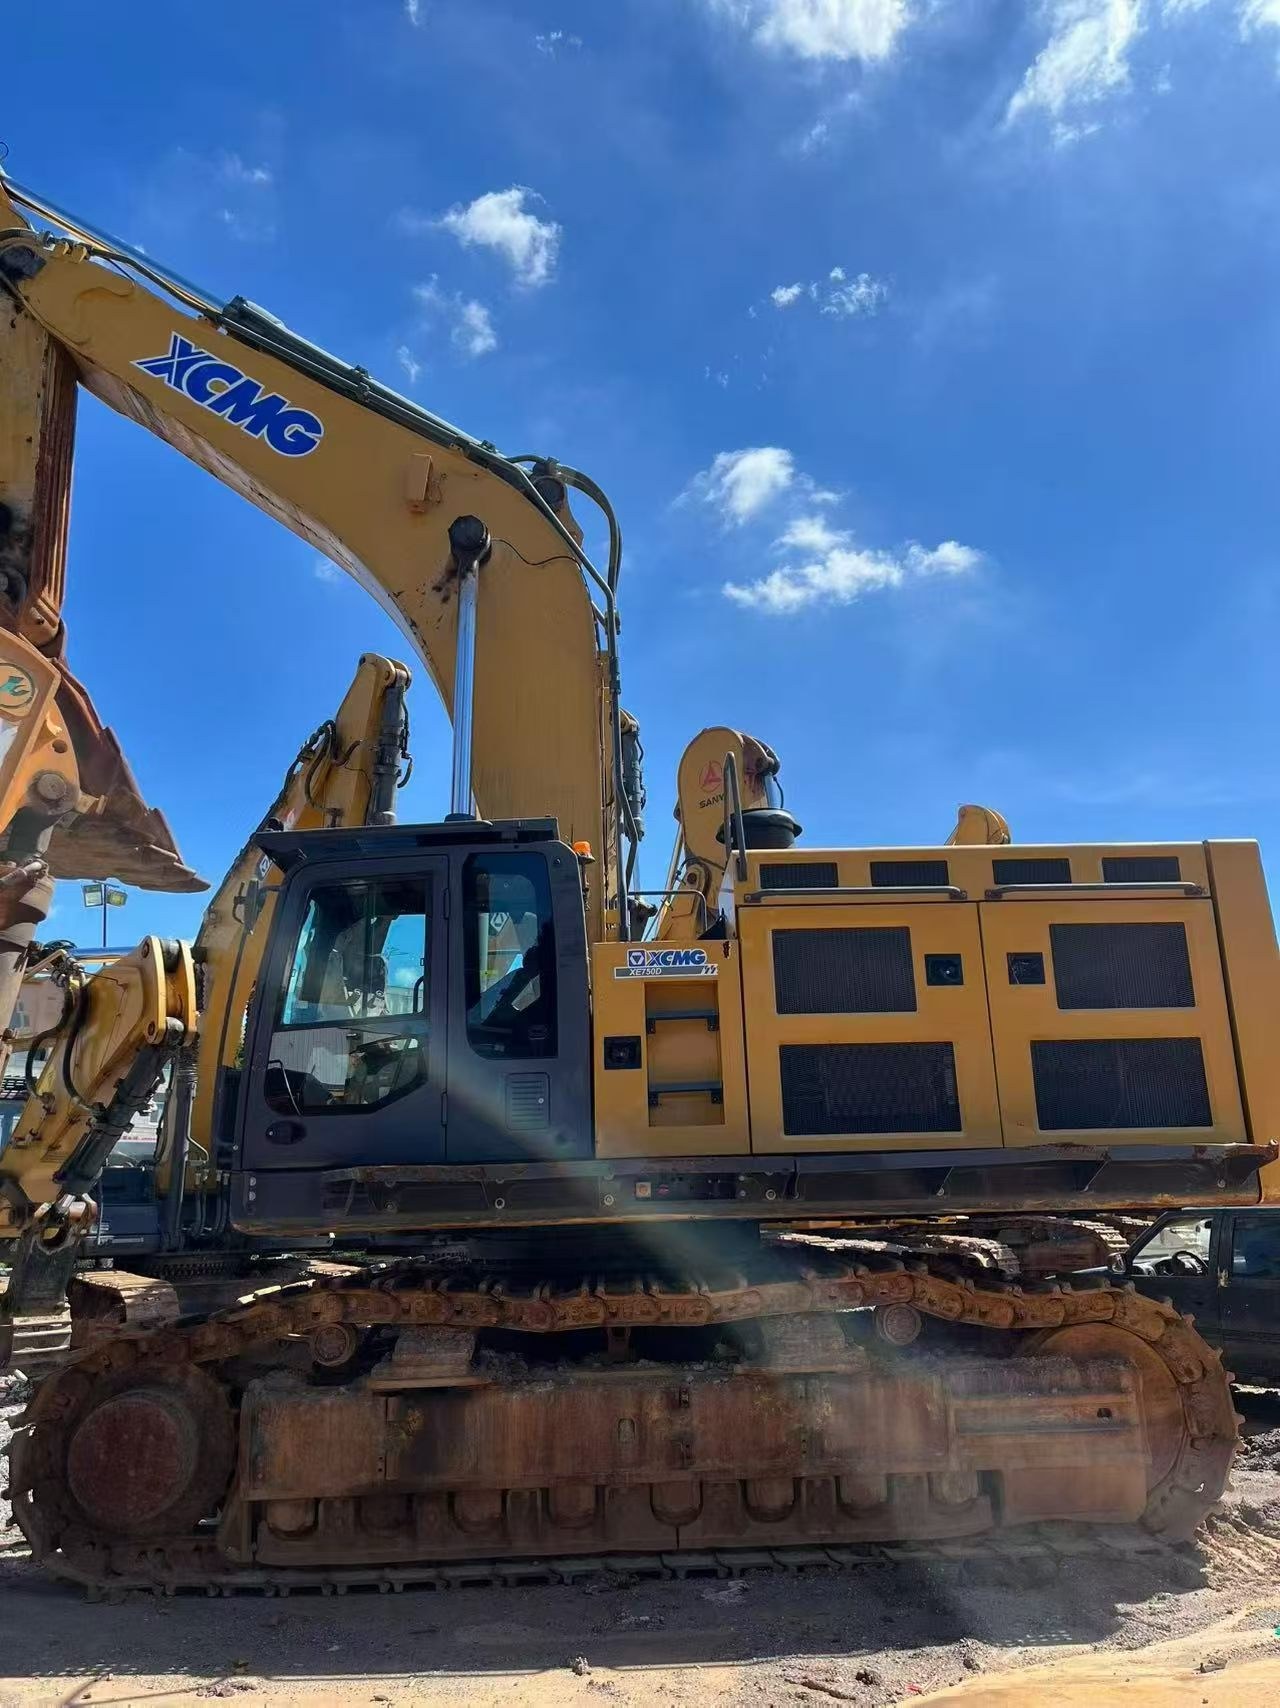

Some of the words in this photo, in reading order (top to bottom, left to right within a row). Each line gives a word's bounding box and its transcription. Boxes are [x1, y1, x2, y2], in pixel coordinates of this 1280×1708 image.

[130, 331, 324, 457] XCMG
[699, 793, 726, 809] SANY
[647, 949, 706, 967] XCMG
[629, 968, 662, 976] XE750D
